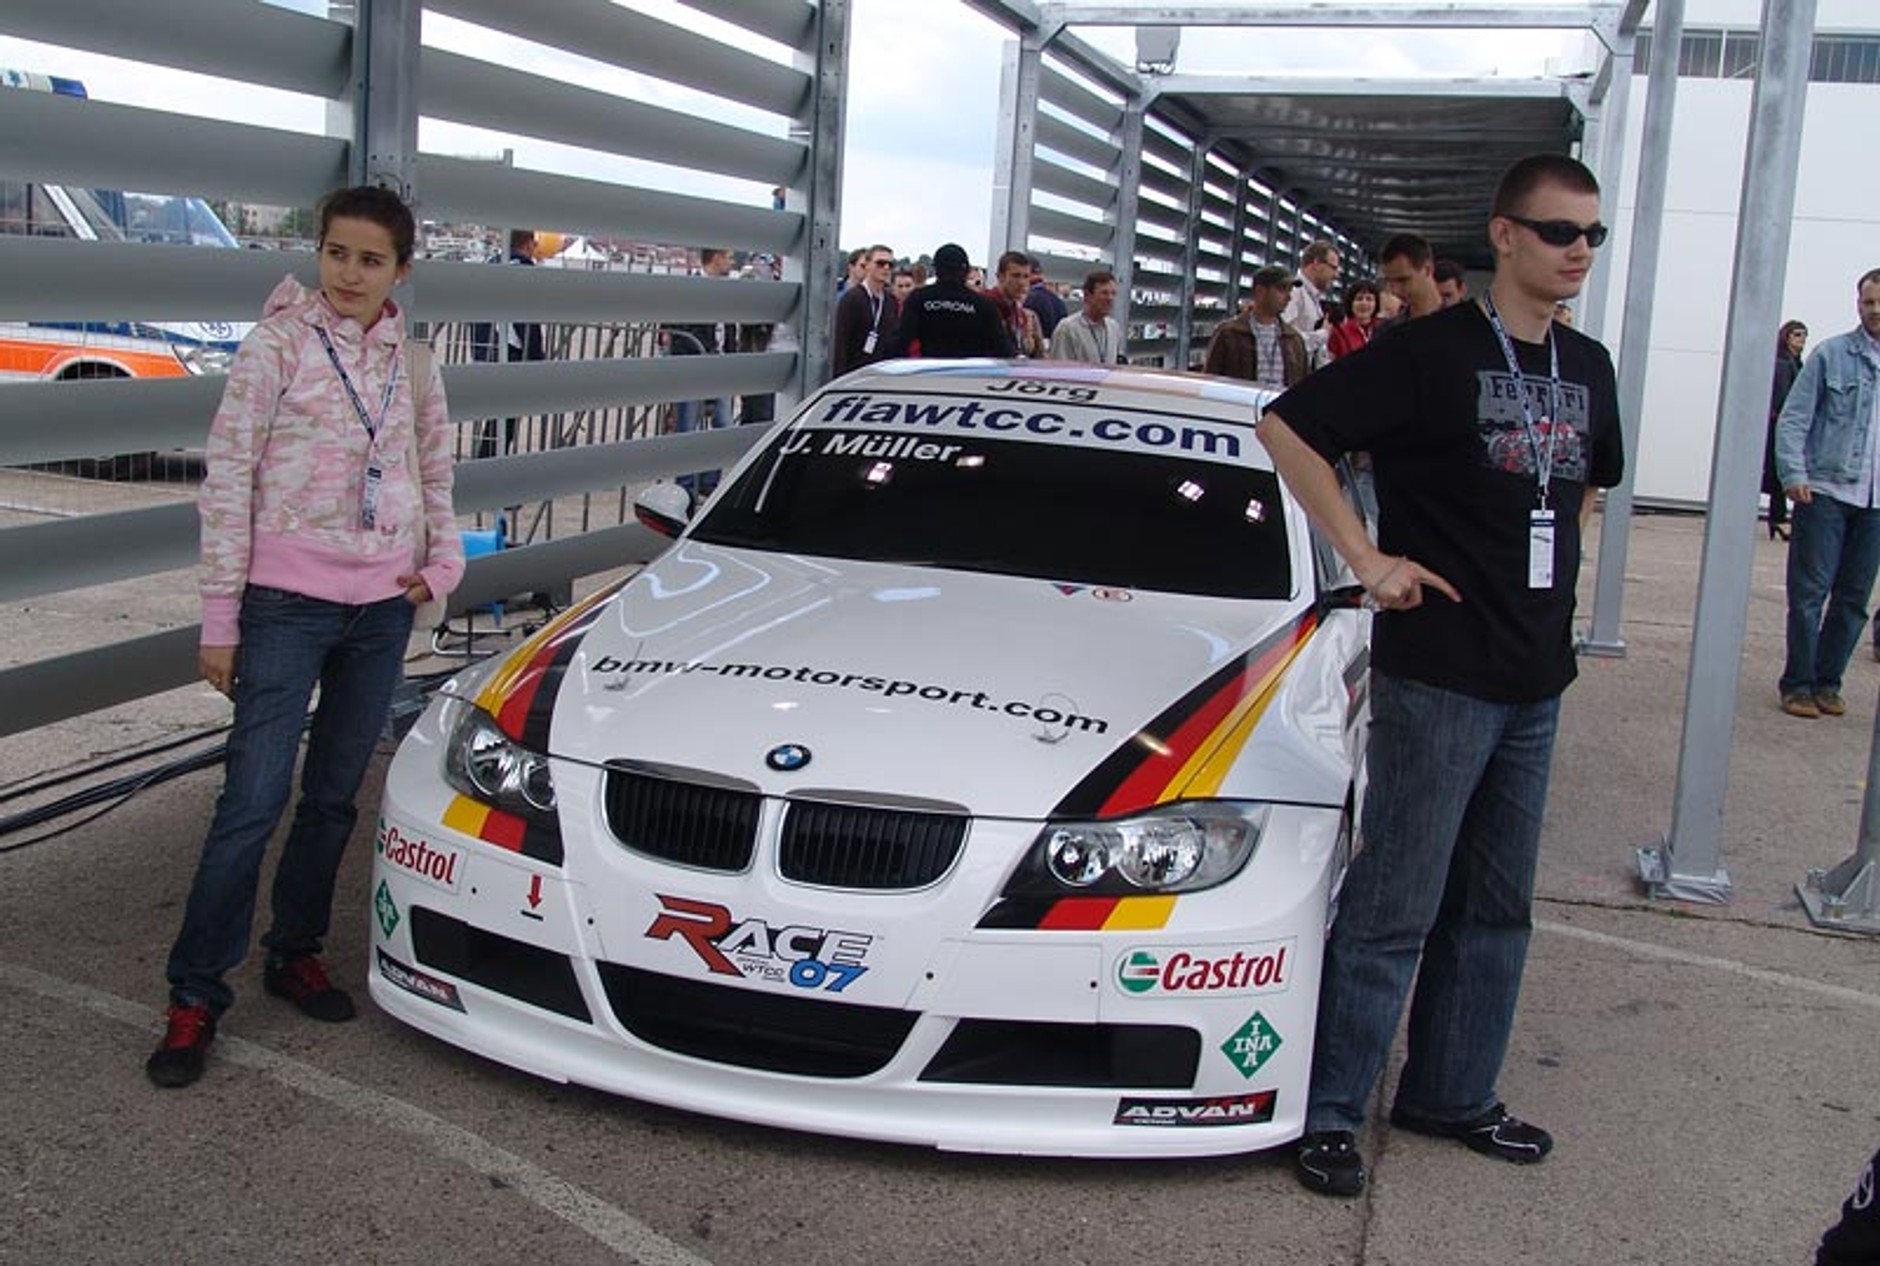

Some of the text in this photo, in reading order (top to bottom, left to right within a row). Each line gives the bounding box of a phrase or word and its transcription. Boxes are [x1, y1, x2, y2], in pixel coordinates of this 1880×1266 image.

[986, 380, 1099, 402] Jörg
[822, 396, 1241, 457] fiawtcc.com
[821, 433, 963, 461] Müller
[591, 655, 1110, 735] bmw-motorsport.com
[385, 827, 458, 884] Castrol
[644, 893, 874, 978] RACE
[789, 957, 869, 993] 07
[1162, 947, 1287, 991] Castrol
[1233, 1034, 1273, 1054] INA
[1121, 1103, 1256, 1119] ADVAN
